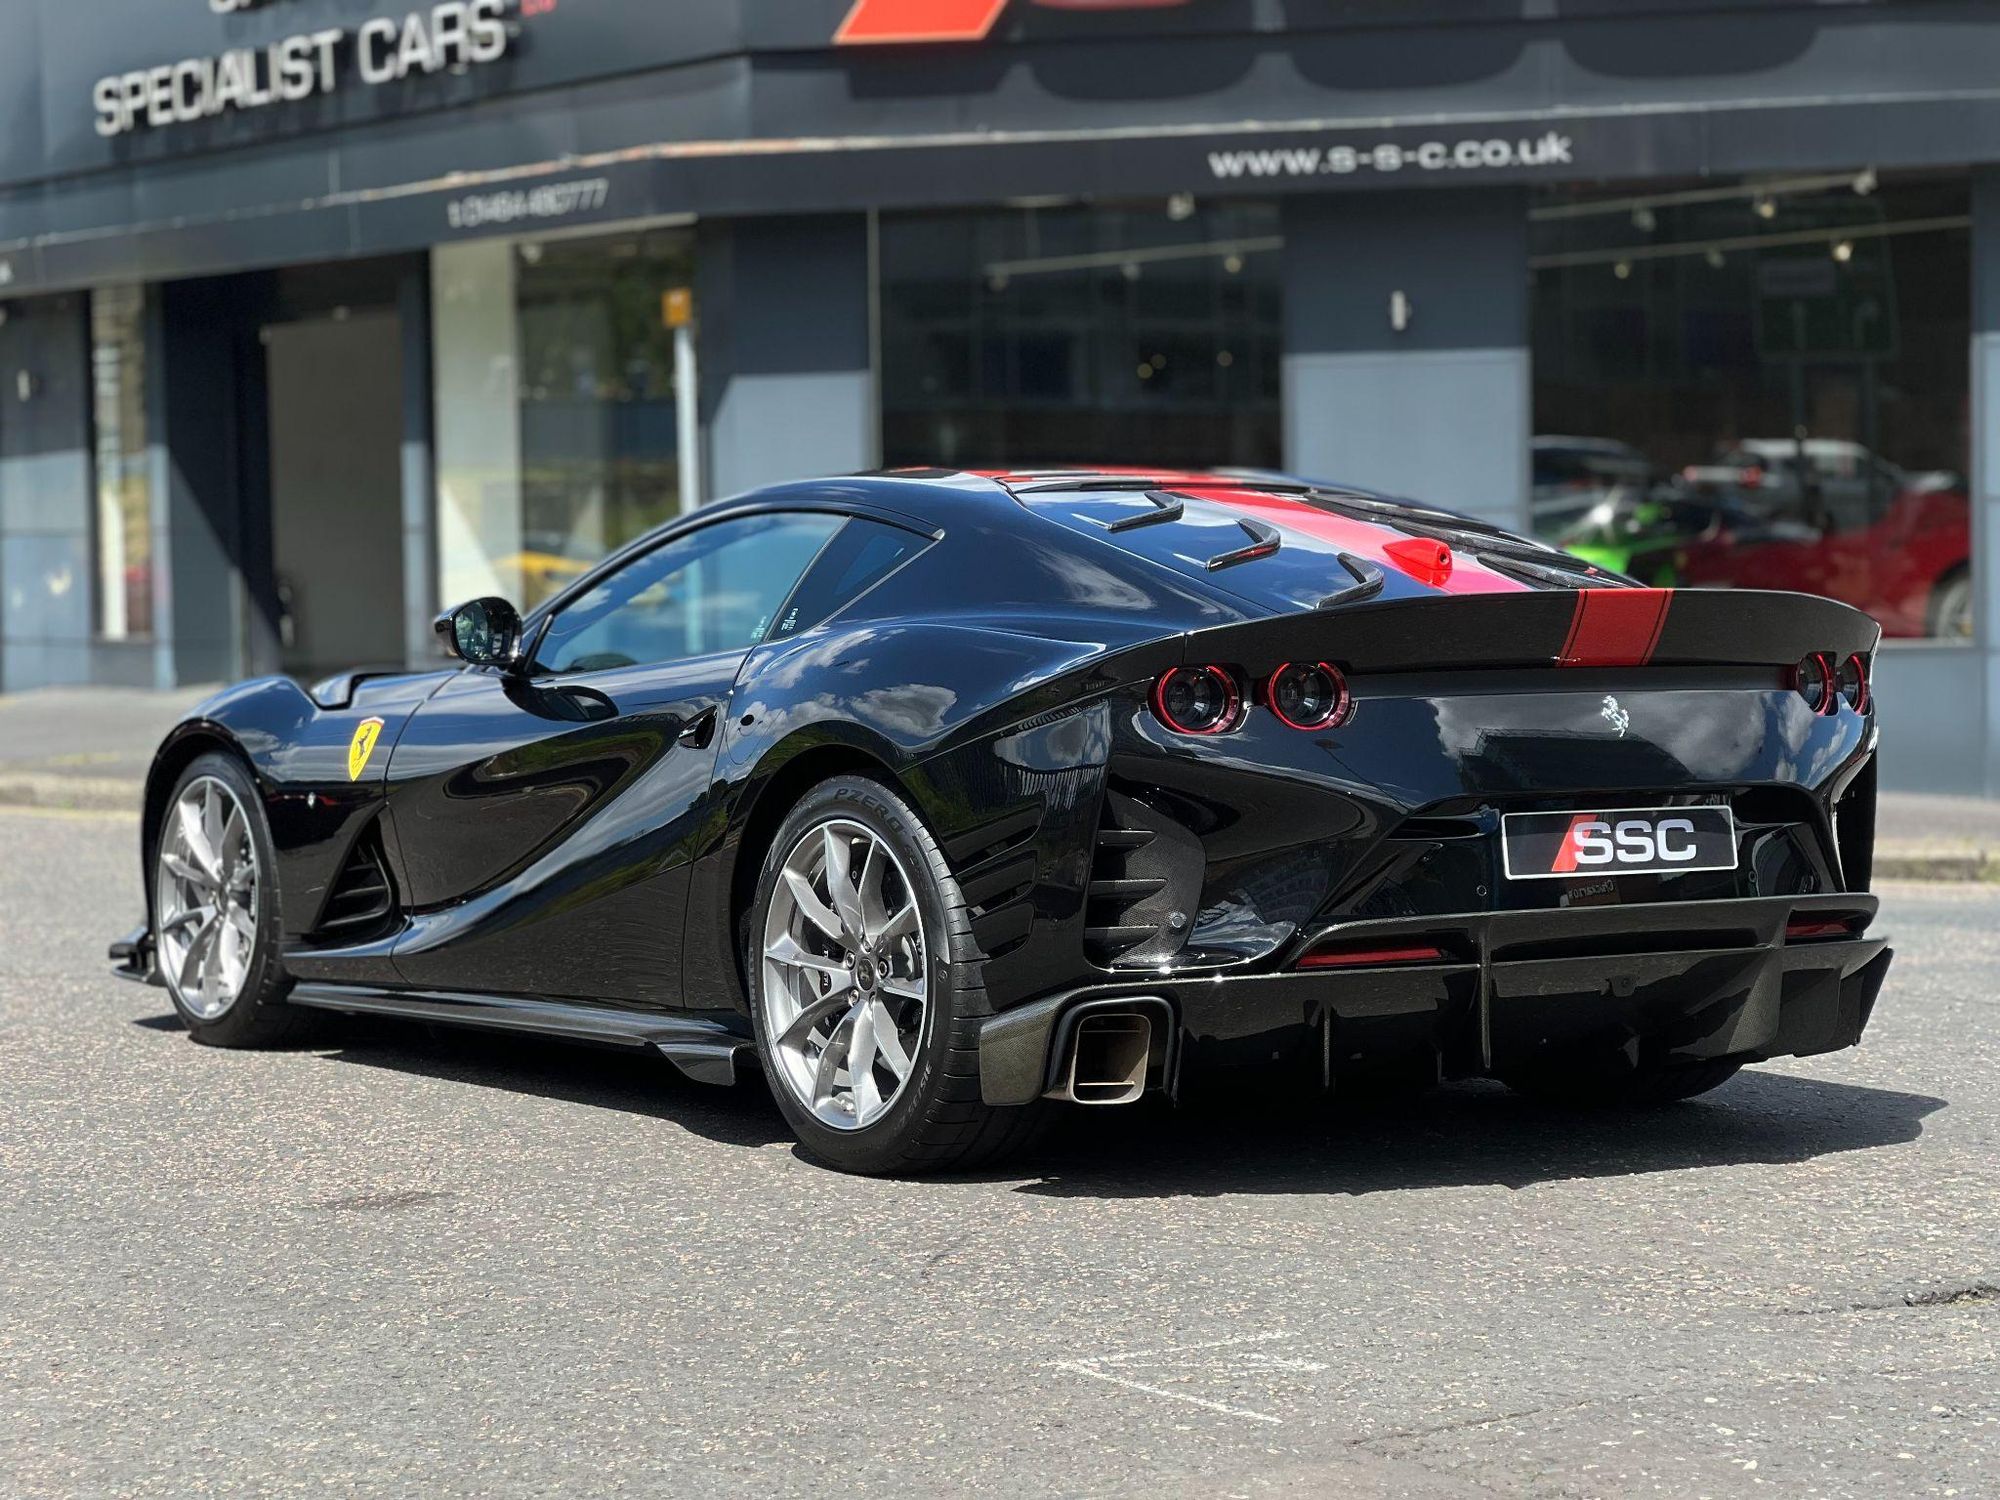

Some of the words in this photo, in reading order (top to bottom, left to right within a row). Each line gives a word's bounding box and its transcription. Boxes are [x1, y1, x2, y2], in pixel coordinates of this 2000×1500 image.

[93, 28, 343, 137] SPECIALIST
[357, 0, 507, 84] CARS
[1207, 132, 1572, 178] www.s-s-c.co.uk
[1573, 818, 1697, 865] SSC
